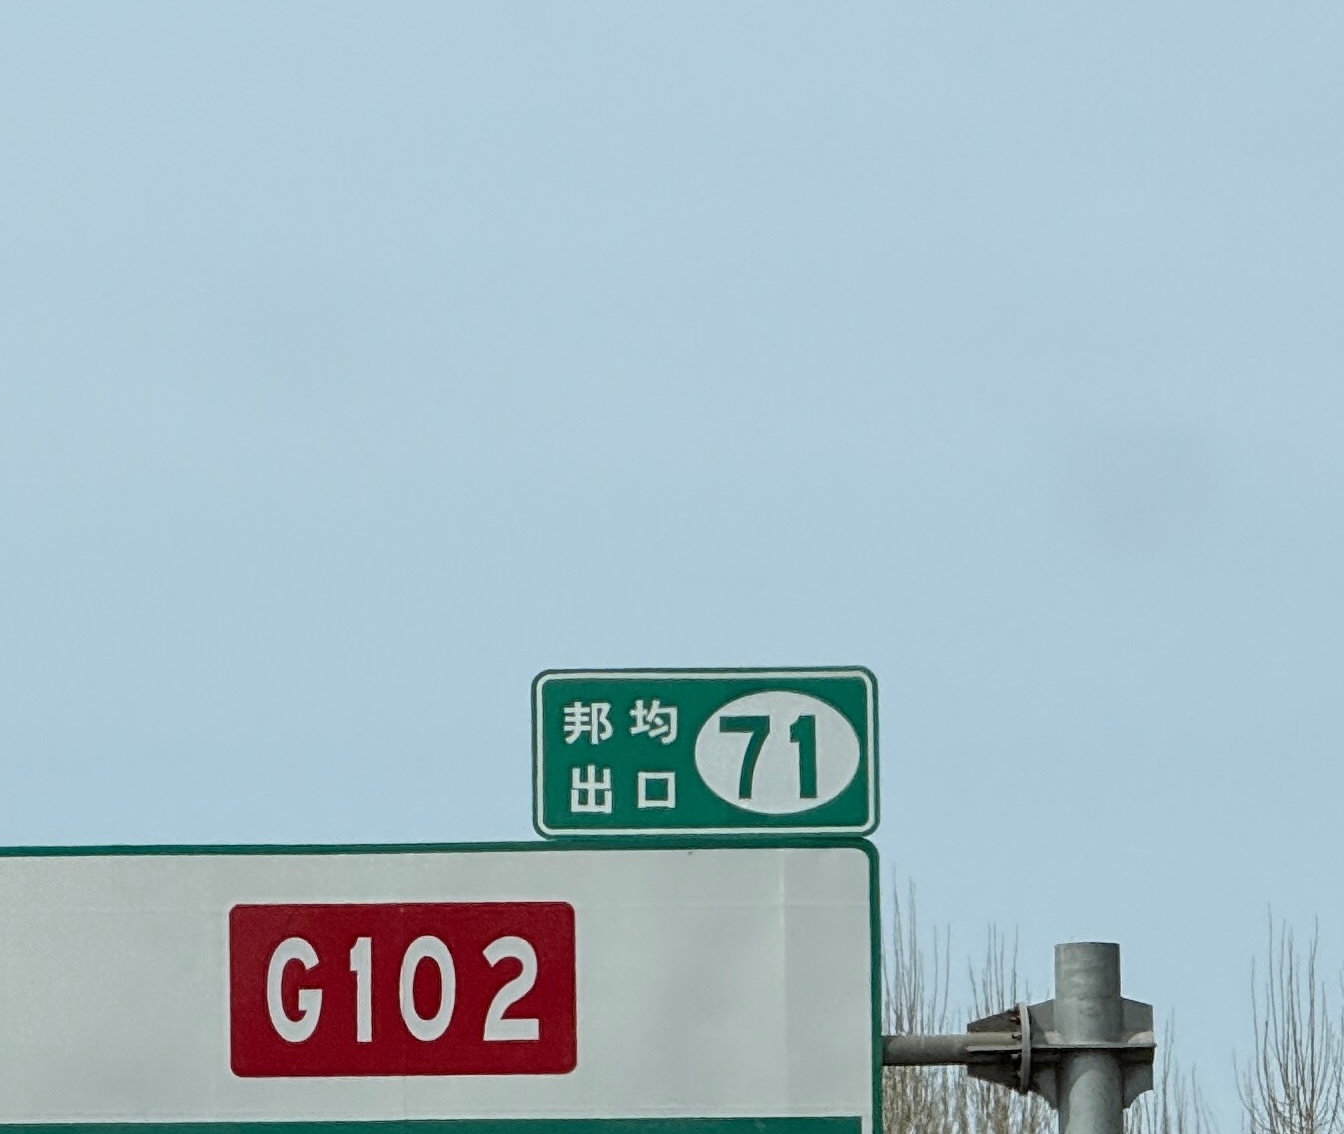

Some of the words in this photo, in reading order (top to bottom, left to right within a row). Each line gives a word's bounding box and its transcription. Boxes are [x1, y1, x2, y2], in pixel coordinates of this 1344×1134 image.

[563, 699, 678, 745] 邦均
[570, 764, 676, 814] 出口
[719, 714, 818, 800] 71
[266, 935, 540, 1043] G102
